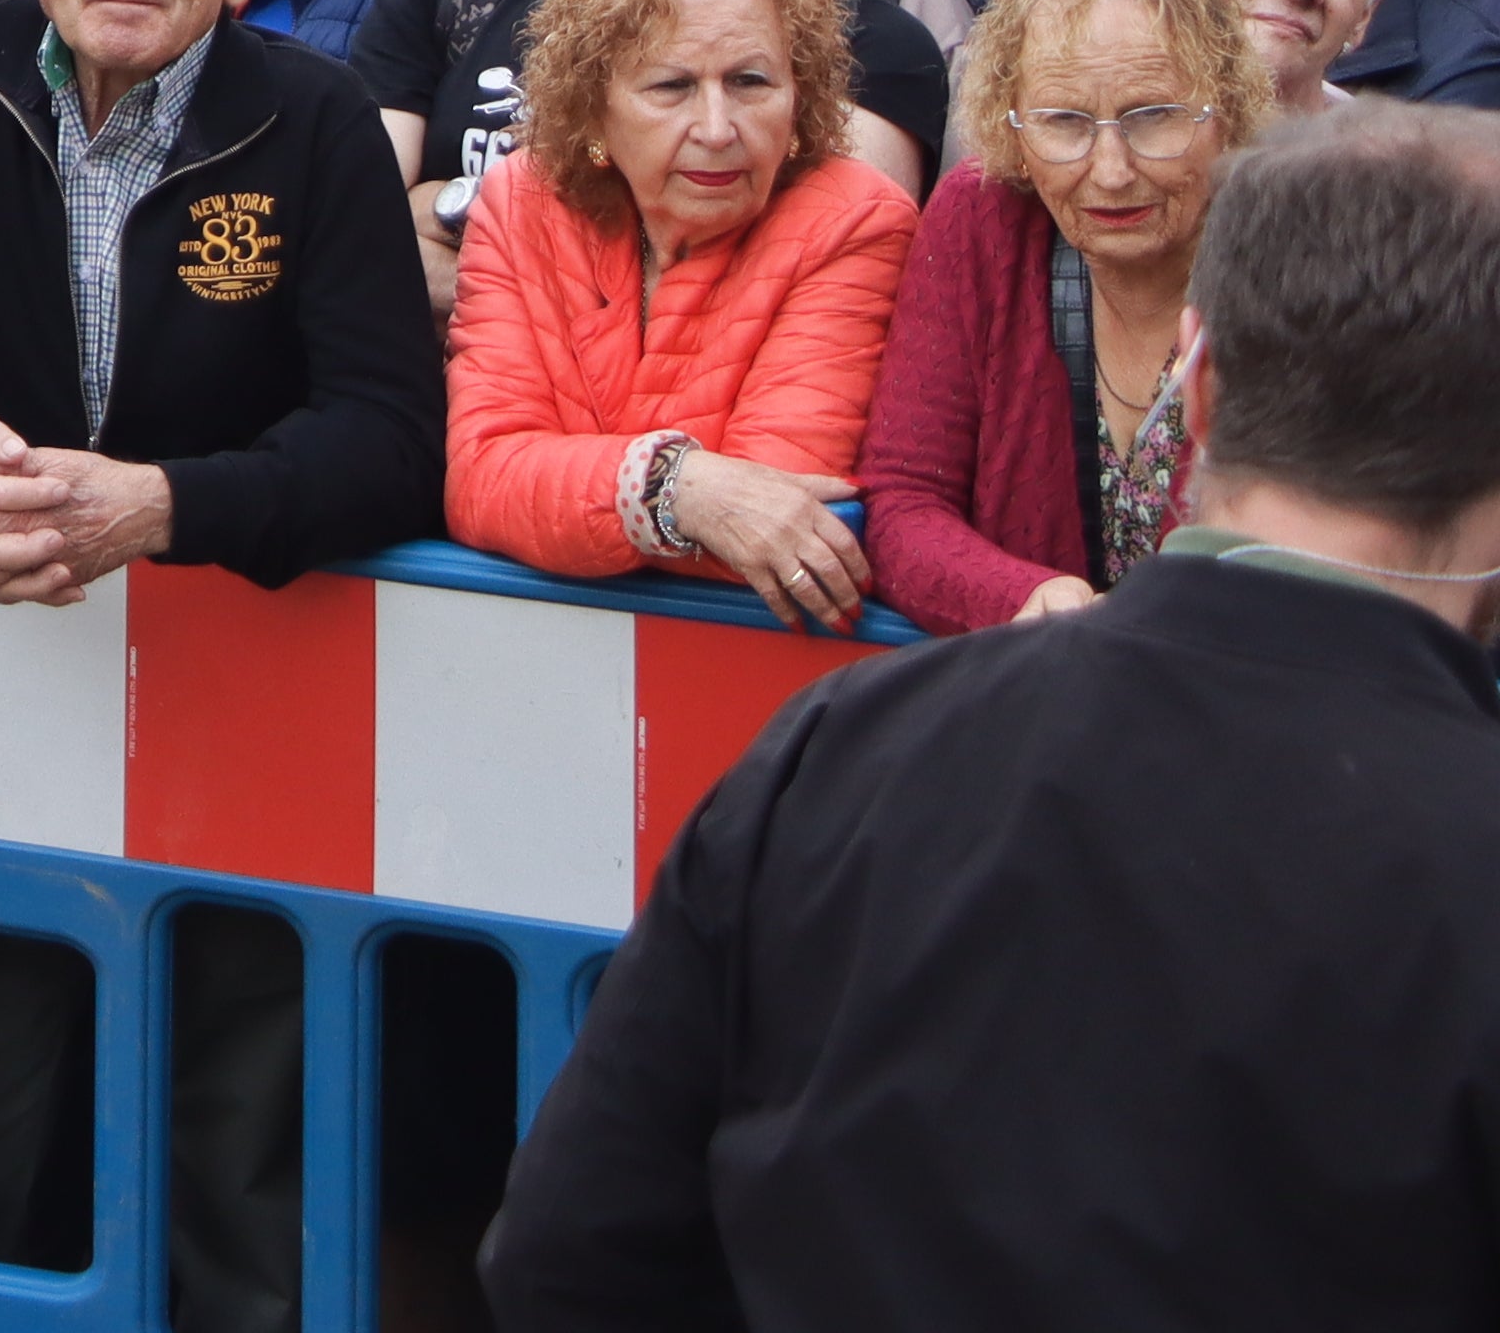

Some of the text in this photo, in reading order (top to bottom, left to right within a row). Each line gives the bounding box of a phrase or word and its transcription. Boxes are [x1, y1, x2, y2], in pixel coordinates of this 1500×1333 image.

[188, 192, 275, 222] NEW YORK
[200, 215, 260, 265] 83
[177, 264, 230, 277] ORIGINAL
